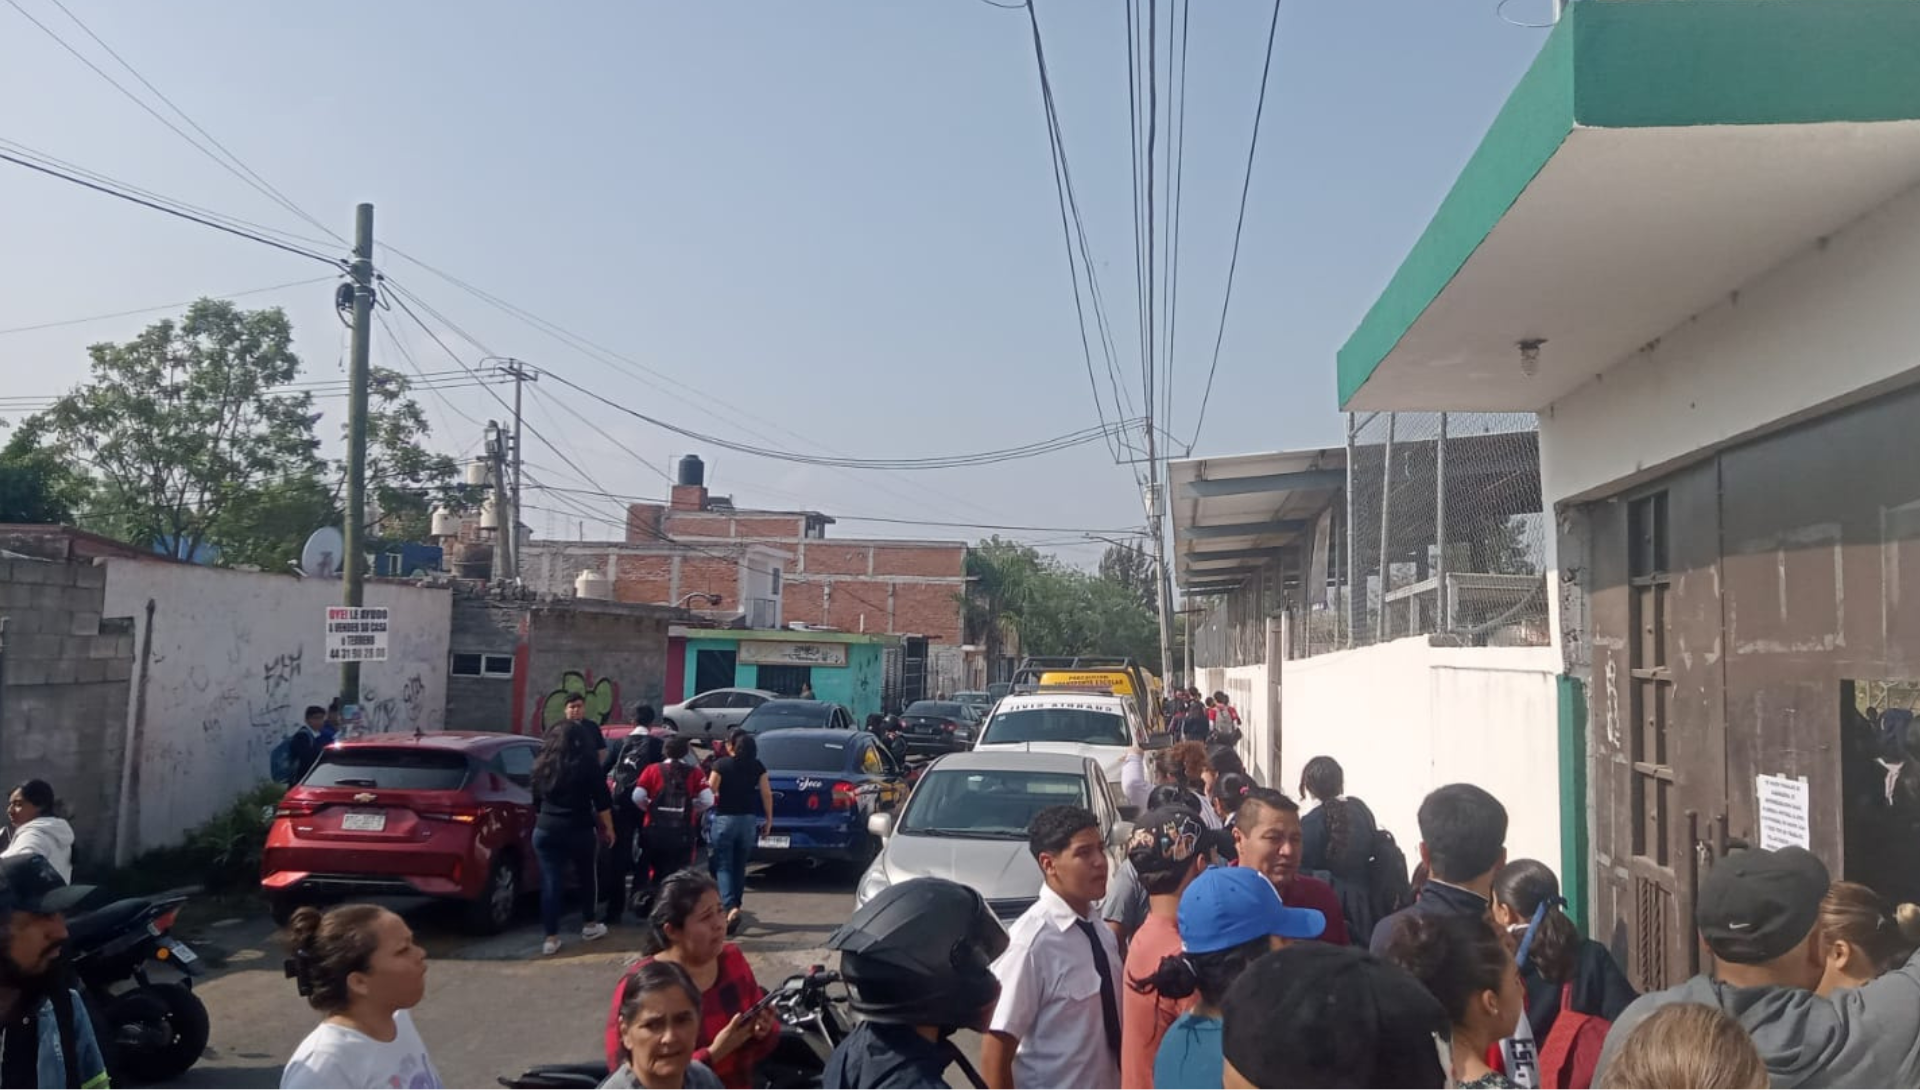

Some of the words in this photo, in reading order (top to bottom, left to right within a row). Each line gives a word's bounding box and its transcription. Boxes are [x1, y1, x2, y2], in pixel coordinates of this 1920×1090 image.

[350, 609, 358, 619] LE
[360, 609, 388, 619] AYUDO
[329, 623, 333, 633] A
[334, 622, 359, 632] VENDER
[361, 622, 369, 632] SU
[371, 622, 387, 632] CASA
[347, 635, 375, 645] TERRENO
[330, 648, 339, 659] 44
